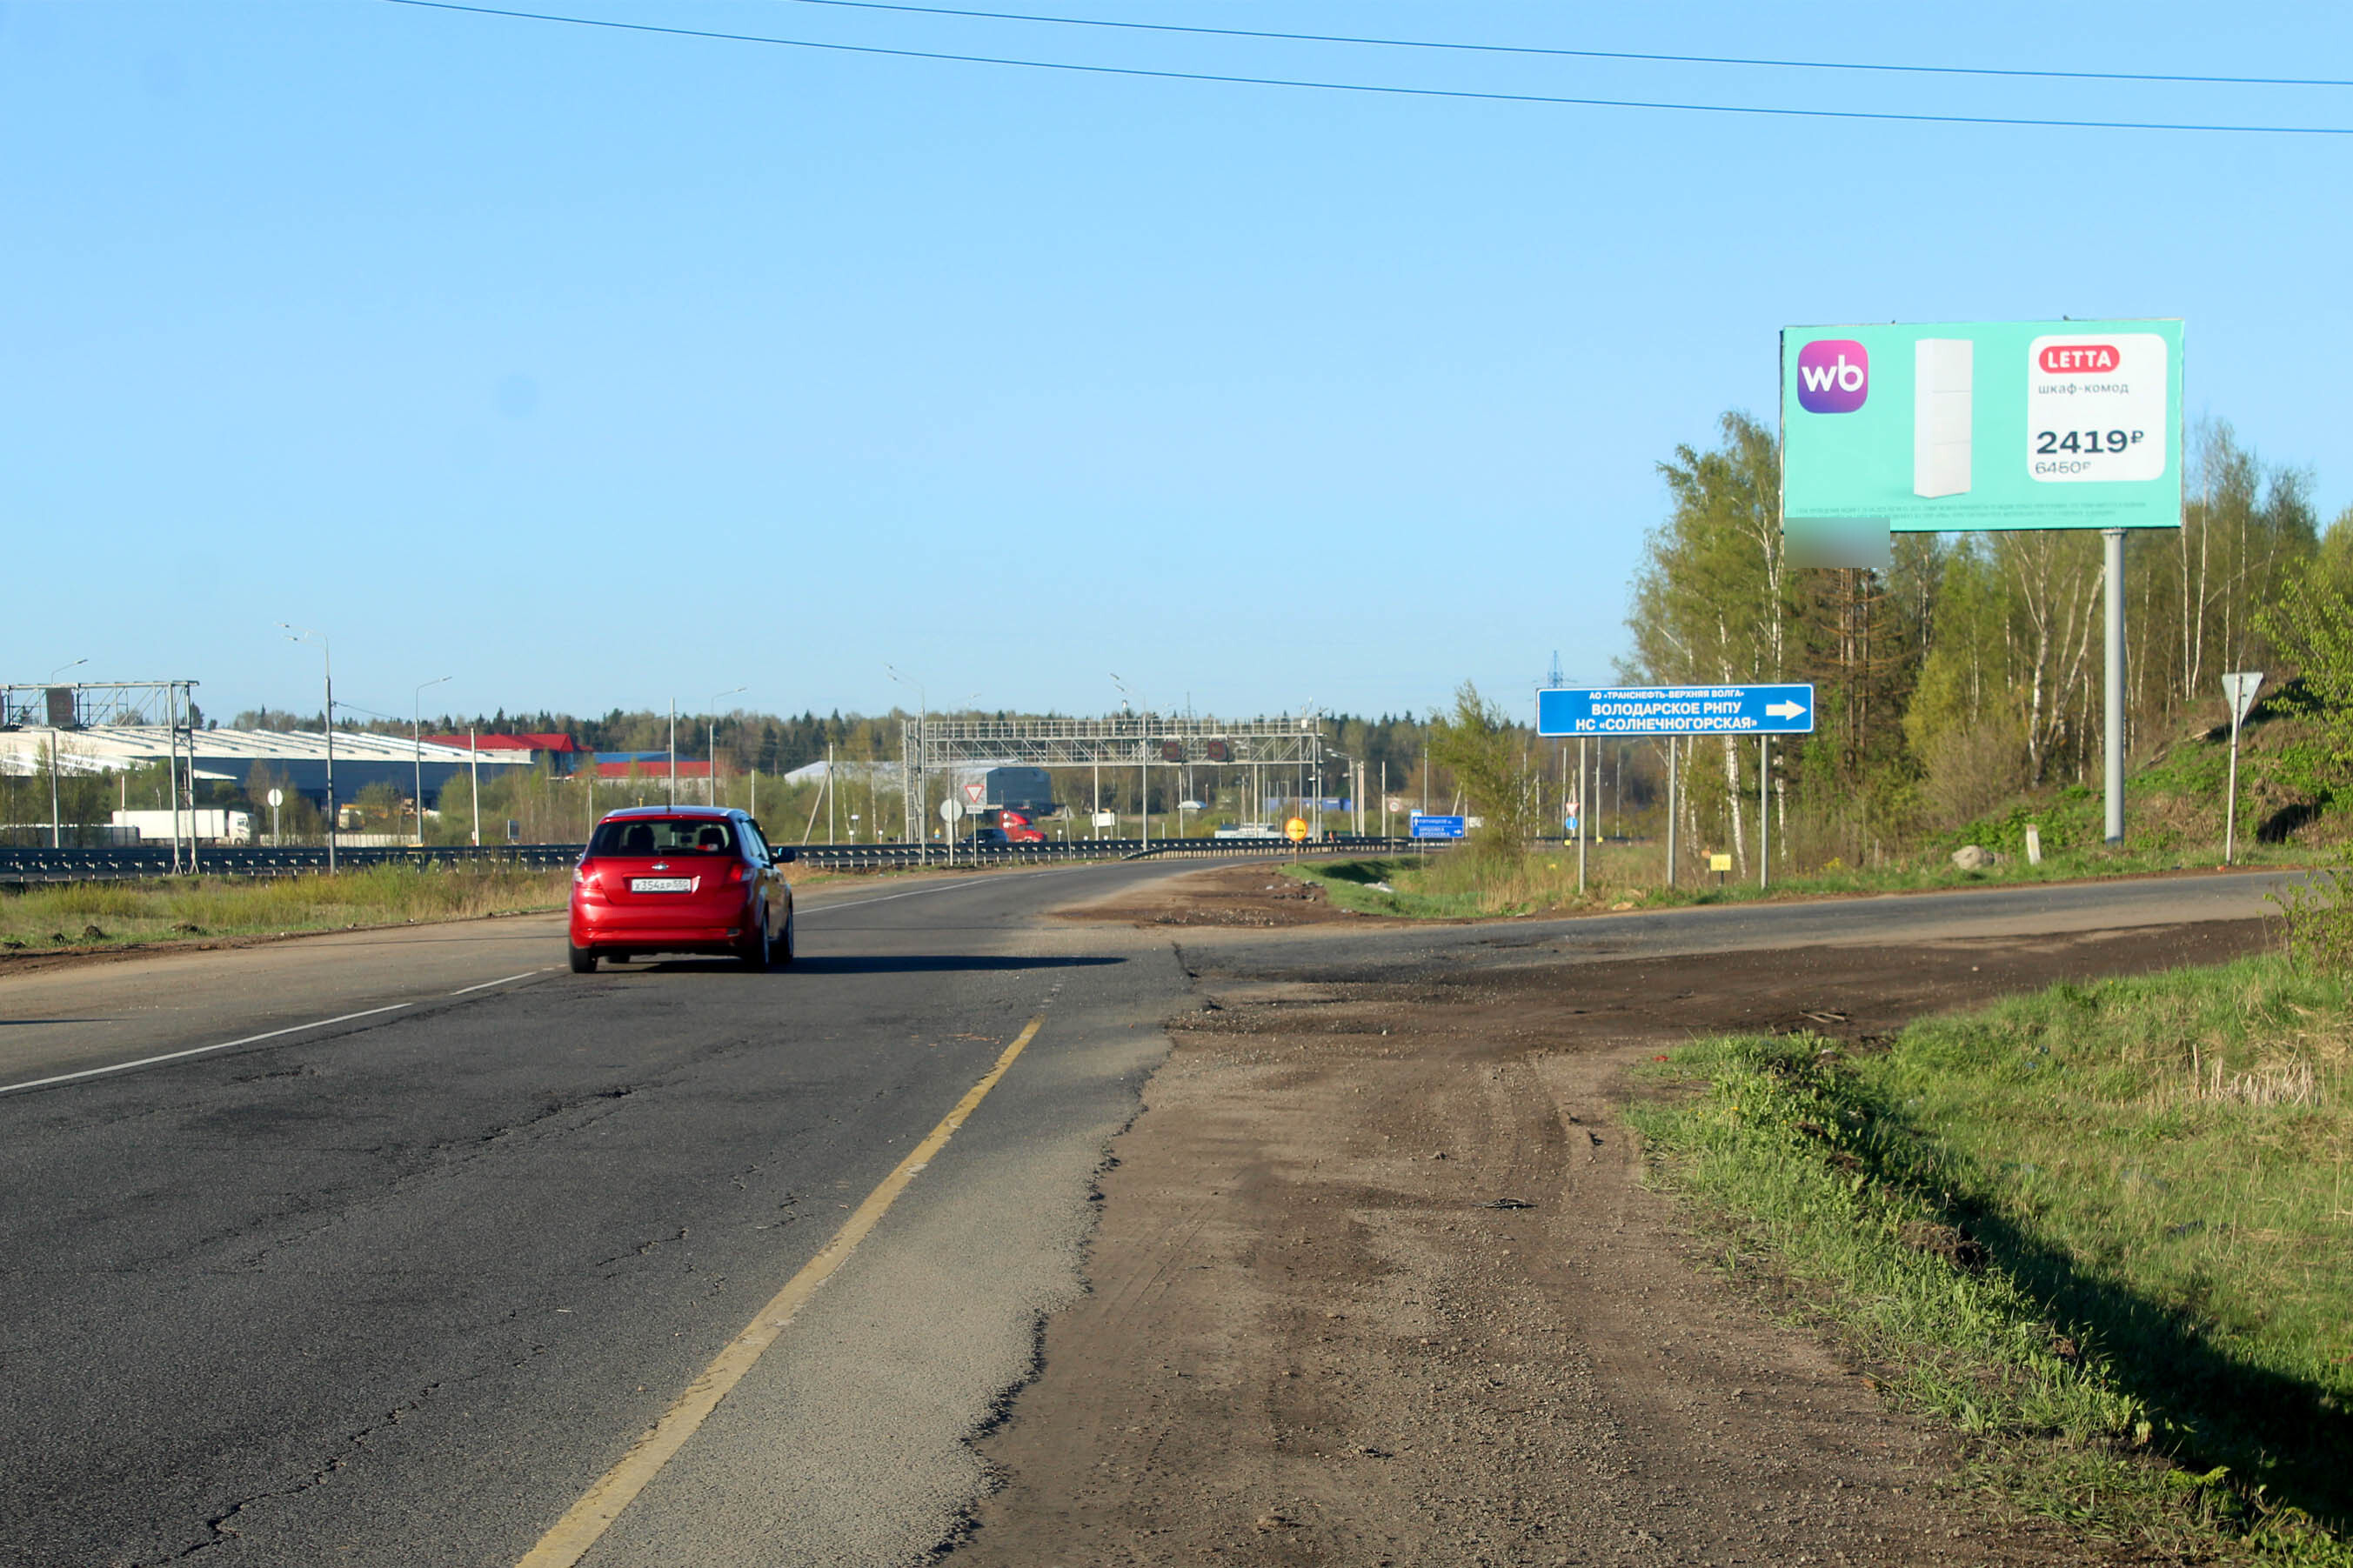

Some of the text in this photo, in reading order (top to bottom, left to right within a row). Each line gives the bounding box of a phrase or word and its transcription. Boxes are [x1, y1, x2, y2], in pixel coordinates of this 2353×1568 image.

[2048, 350, 2112, 369] LETTA
[1801, 354, 1864, 392] wb
[2038, 383, 2129, 395] шкаф-комод
[1588, 691, 1601, 700] АО
[1591, 701, 1741, 717] ВОЛОДАРСКОЕ РНПУ
[1575, 717, 1757, 731] НС «СОЛНЕЧНОГОРСКАЯ»
